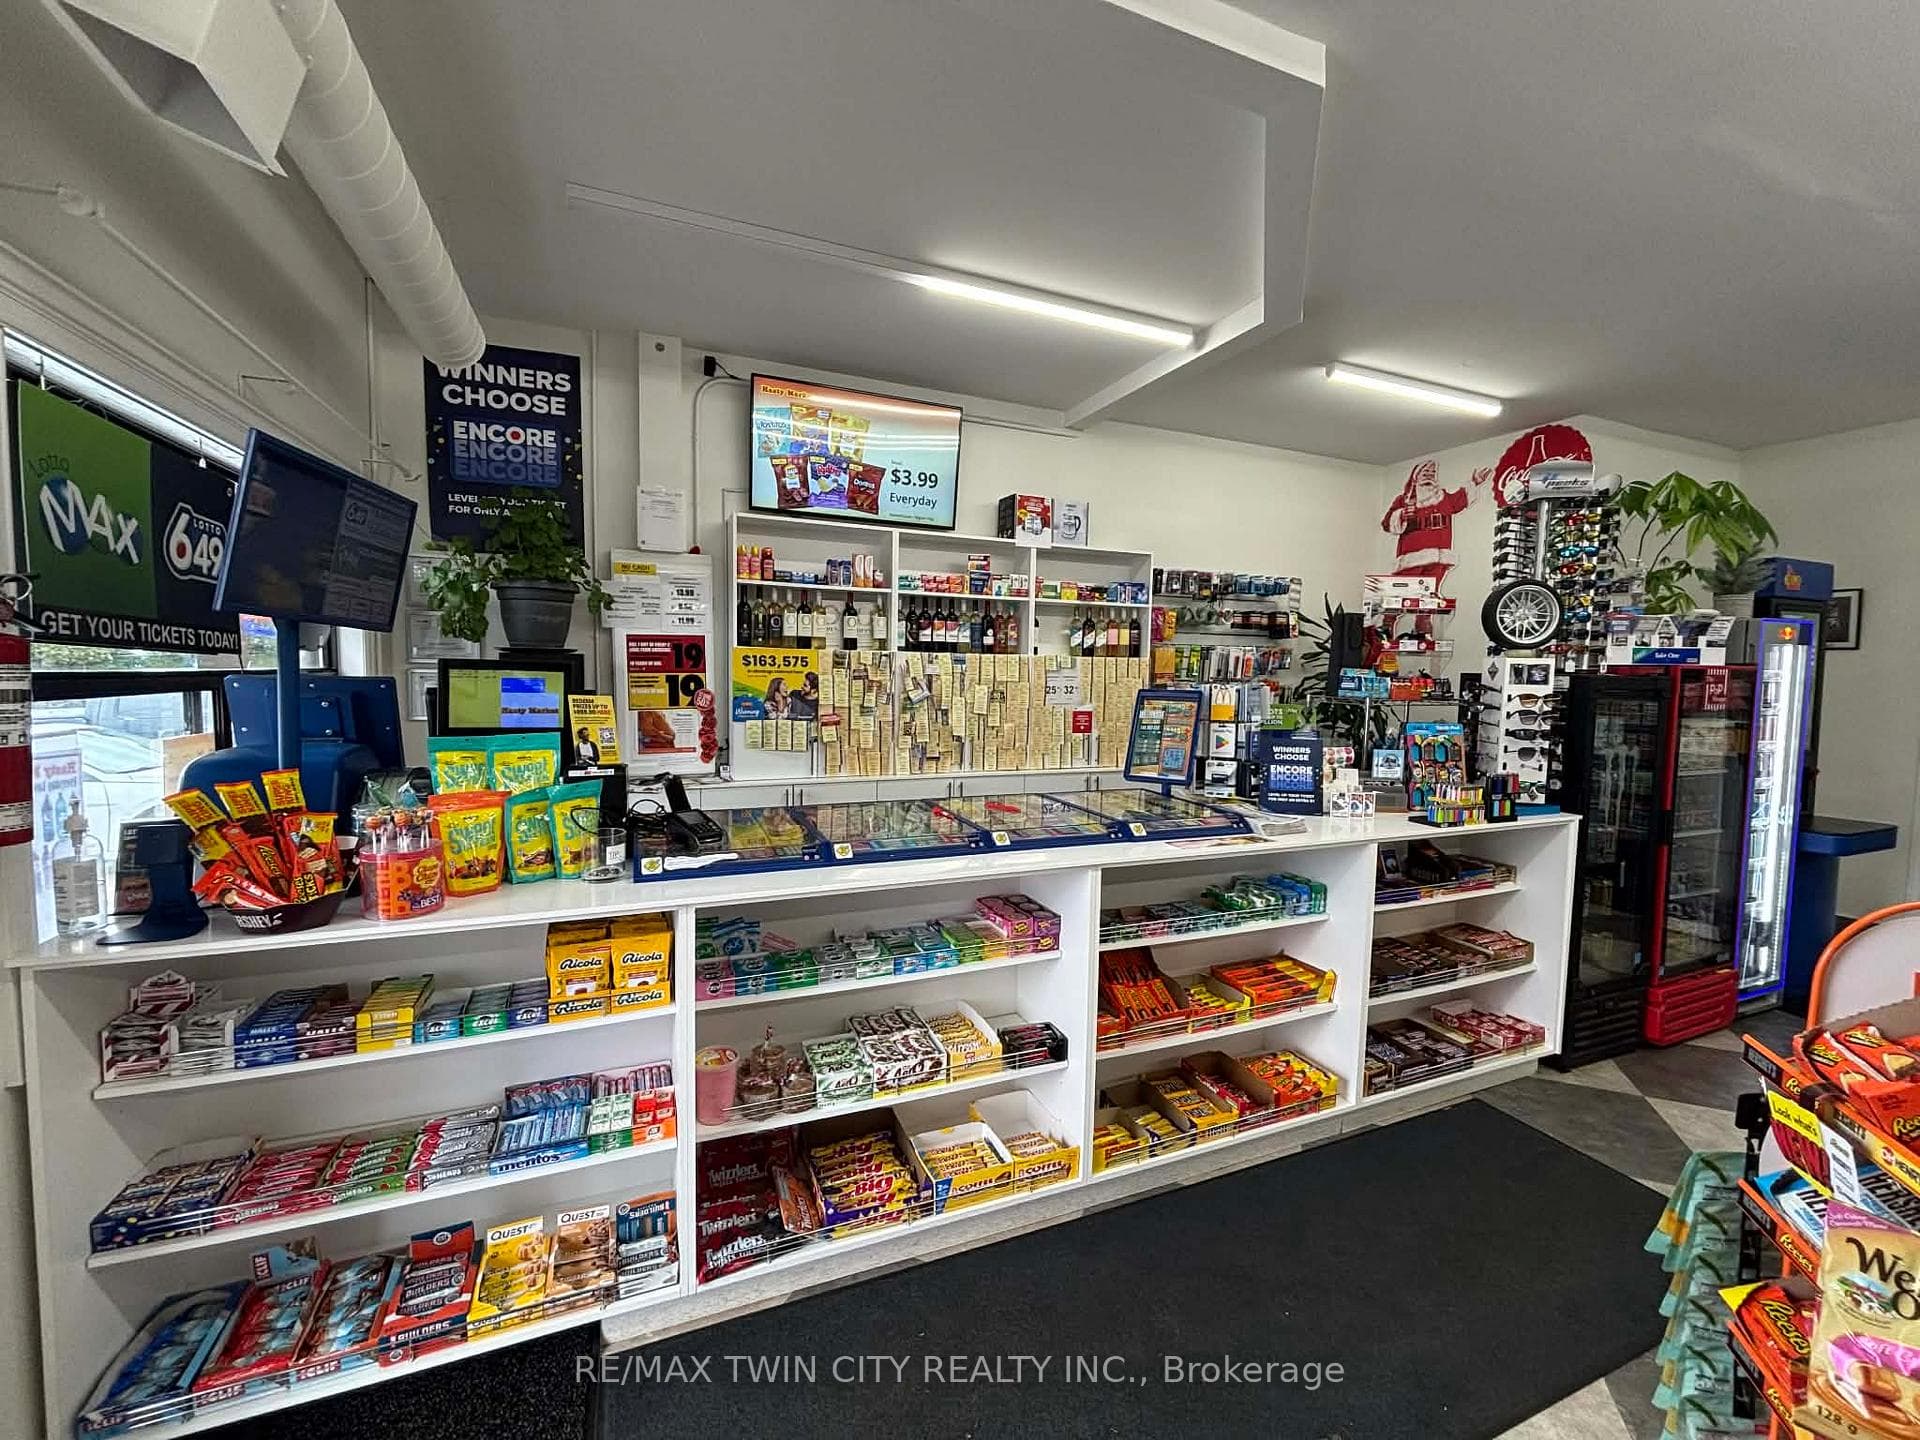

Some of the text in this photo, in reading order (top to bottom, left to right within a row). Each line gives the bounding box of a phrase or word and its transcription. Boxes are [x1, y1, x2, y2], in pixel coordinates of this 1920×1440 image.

[437, 363, 571, 392] WINNERS
[442, 384, 566, 416] CHOOSE
[453, 421, 557, 448] ENCORE
[453, 440, 557, 466] ENCORE
[454, 458, 558, 483] ENCORE
[890, 469, 938, 489] $3.99
[889, 492, 938, 509] Everyday
[448, 505, 470, 515] FOR
[473, 507, 501, 517] ONLY
[39, 479, 140, 565] MAX
[193, 519, 222, 534] LOTTO
[41, 610, 240, 650] GET YOUR TICKETS TODAY!
[672, 643, 704, 669] 19
[742, 655, 809, 668] $163,575
[665, 674, 705, 707] 19
[1270, 765, 1312, 774] ENCORE
[560, 957, 602, 971] Ricola
[622, 952, 663, 964] Ricola
[617, 990, 662, 1005] Ricola
[555, 1000, 602, 1015] Ricola
[499, 1153, 561, 1172] mentos
[560, 1210, 596, 1223] QUEST
[491, 1224, 529, 1242] QUEST
[1817, 1405, 1859, 1436] 128 g
